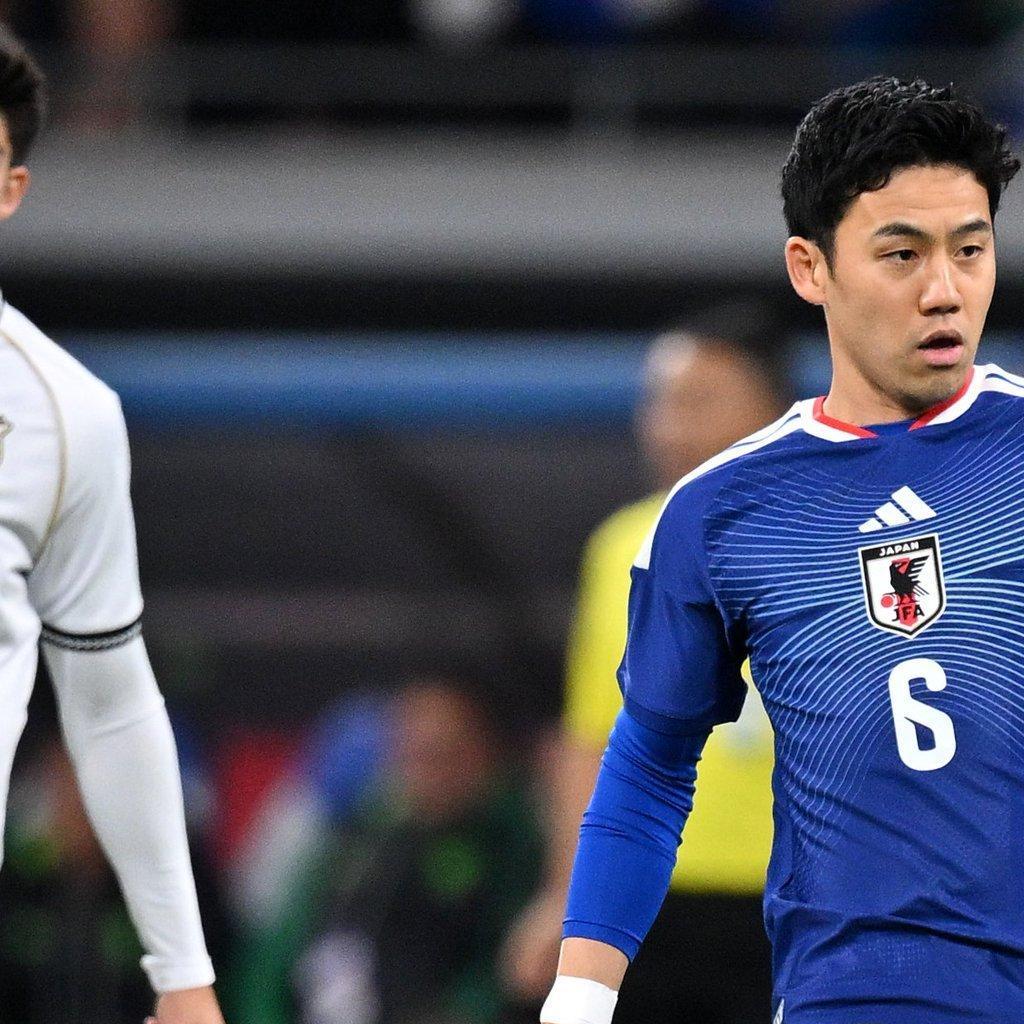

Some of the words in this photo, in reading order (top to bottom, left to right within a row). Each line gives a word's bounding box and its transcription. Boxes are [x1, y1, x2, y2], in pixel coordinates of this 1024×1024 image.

[879, 541, 920, 557] JAPAN
[891, 604, 925, 622] JFA
[888, 657, 957, 772] 6
